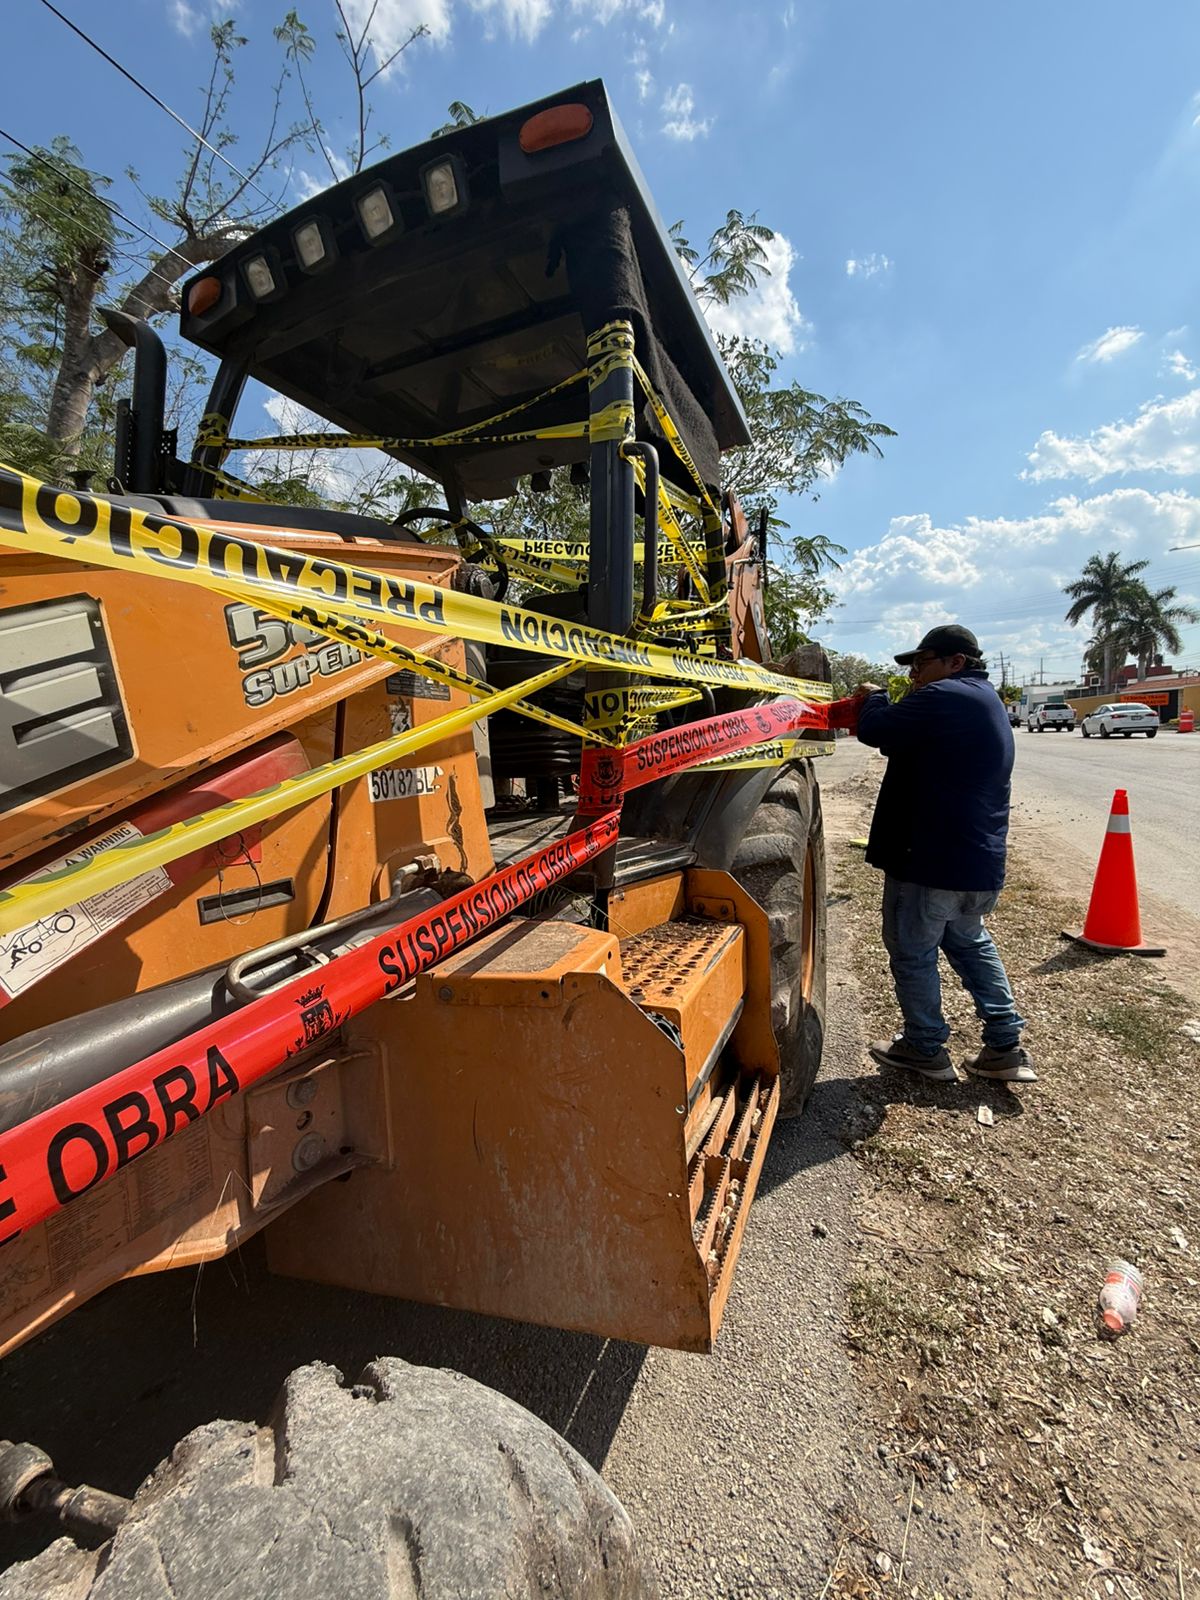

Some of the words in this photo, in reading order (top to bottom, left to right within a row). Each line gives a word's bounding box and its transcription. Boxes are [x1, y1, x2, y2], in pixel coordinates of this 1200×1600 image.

[637, 727, 709, 771] SUSPENSION
[708, 722, 724, 744] DE
[722, 716, 751, 739] OBRA
[78, 827, 132, 860] WARNING
[378, 875, 518, 993] SUSPENSION
[517, 861, 541, 902] DE
[538, 841, 578, 884] OBRA
[47, 1045, 240, 1206] OBRA
